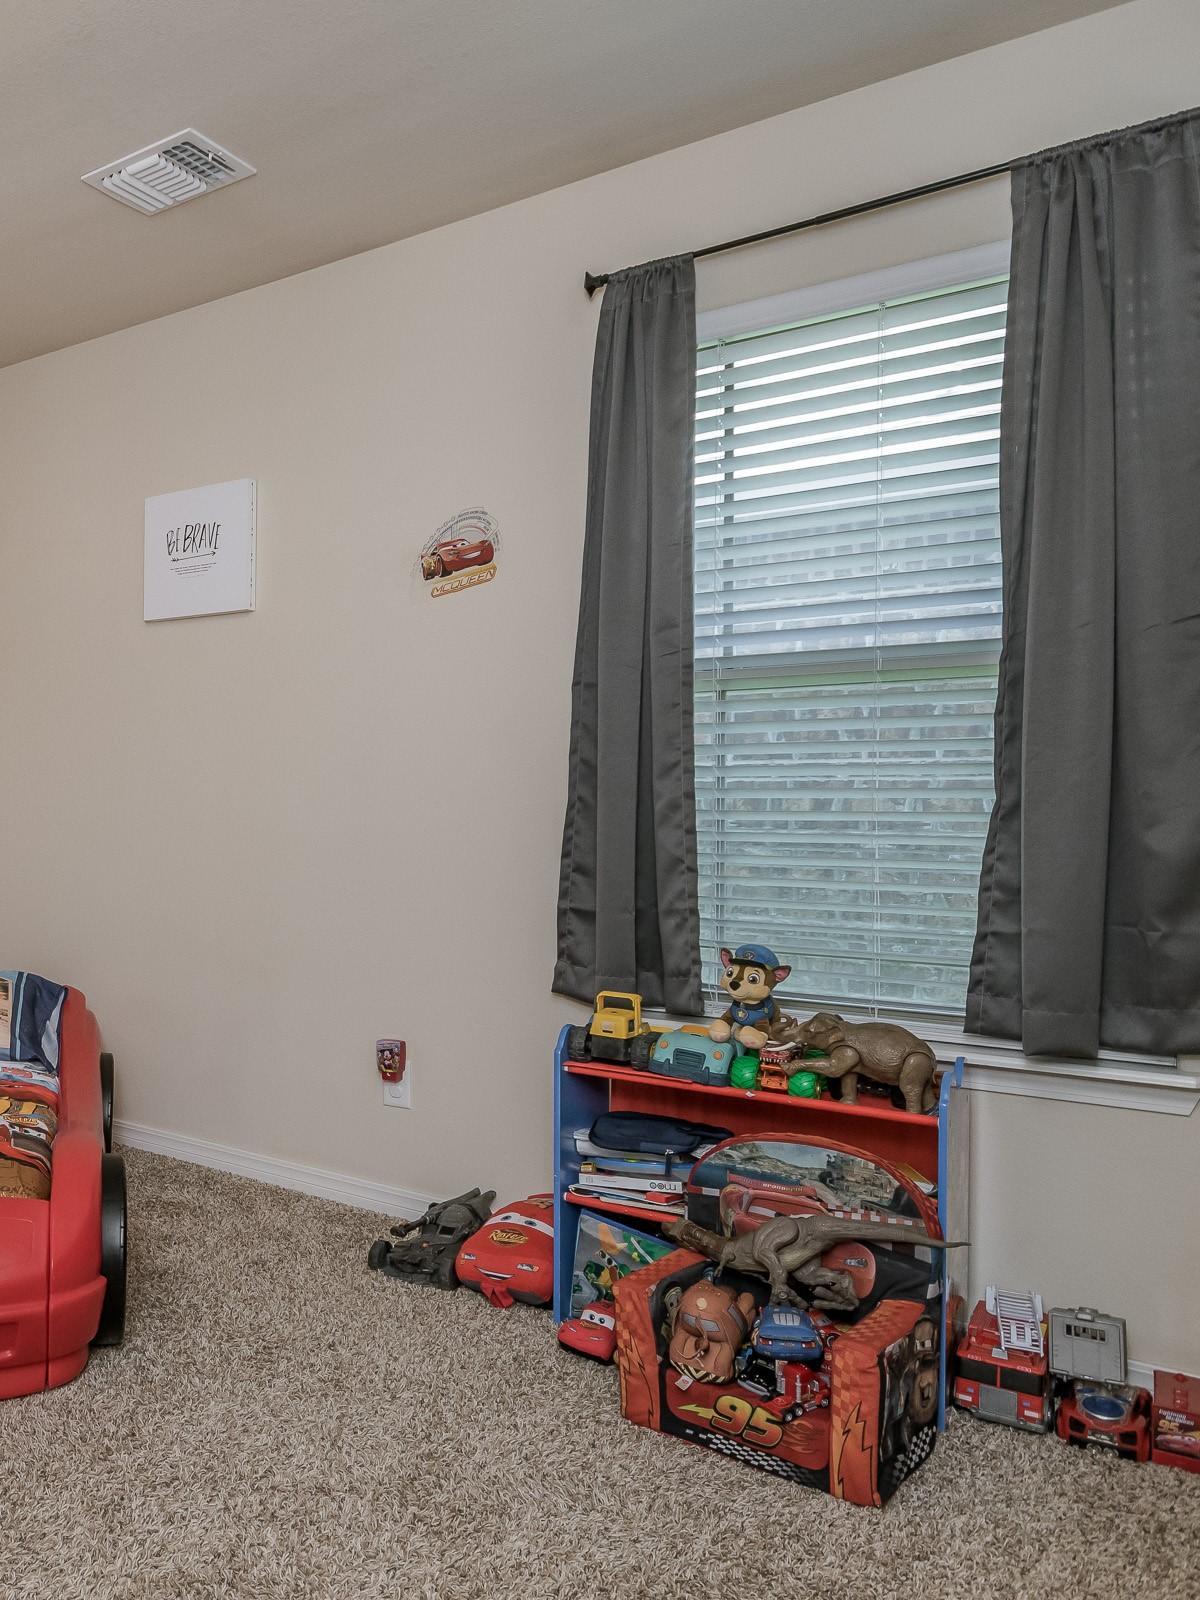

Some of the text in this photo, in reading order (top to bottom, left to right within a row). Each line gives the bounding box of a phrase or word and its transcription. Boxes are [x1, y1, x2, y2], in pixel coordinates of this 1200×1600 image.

[166, 522, 222, 556] BE BRAVE
[710, 1395, 784, 1448] 95
